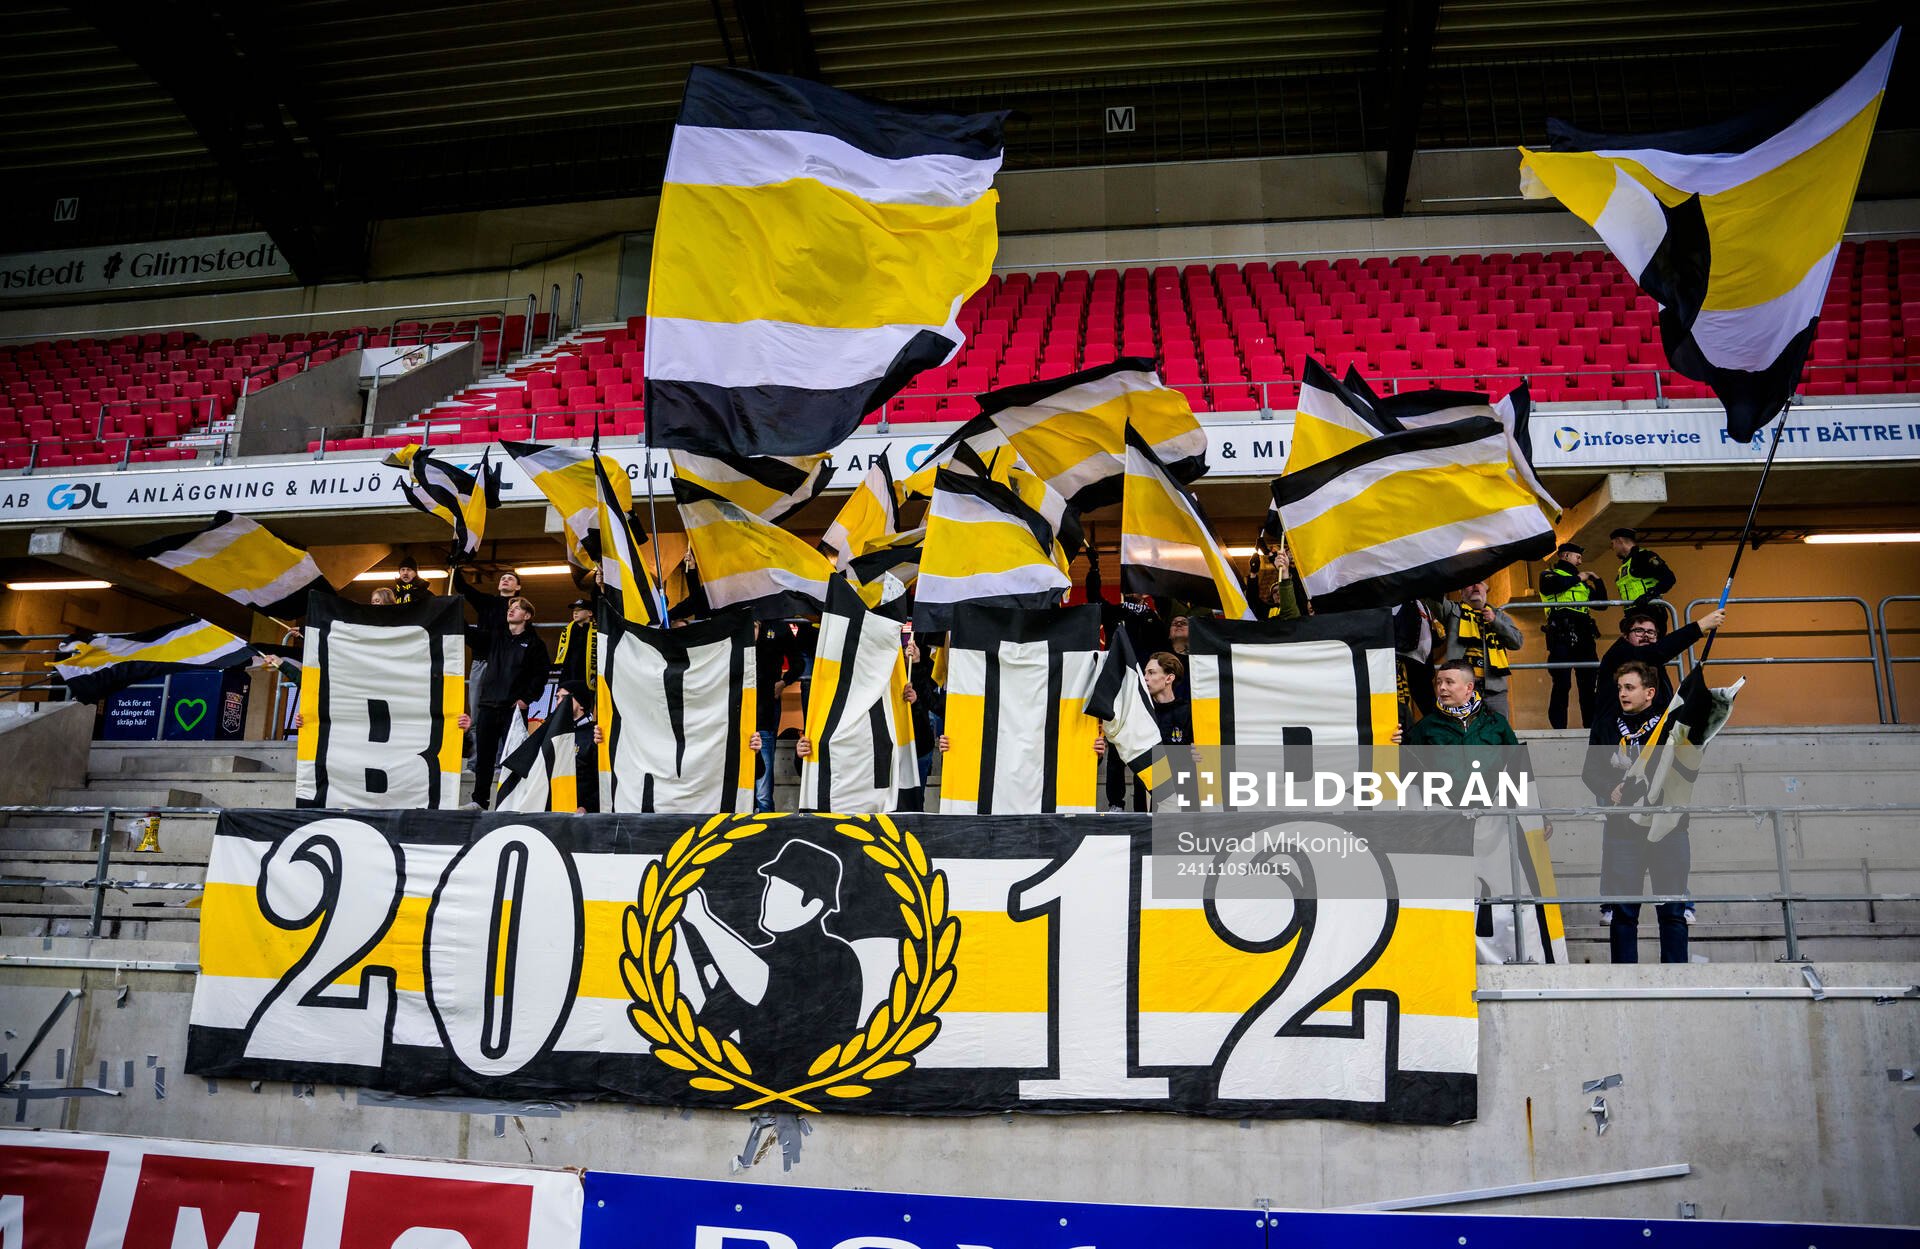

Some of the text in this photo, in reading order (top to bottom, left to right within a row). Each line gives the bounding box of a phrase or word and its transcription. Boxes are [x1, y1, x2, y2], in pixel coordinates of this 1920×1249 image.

[1108, 108, 1134, 131] M
[130, 243, 279, 278] Glimstedt
[1583, 429, 1701, 446] infoservice
[1816, 421, 1903, 443] BÄTTRE
[127, 481, 275, 504] ANLÄGGNING
[285, 480, 298, 496] &
[310, 473, 381, 494] MILJÖ
[2, 493, 30, 508] AB
